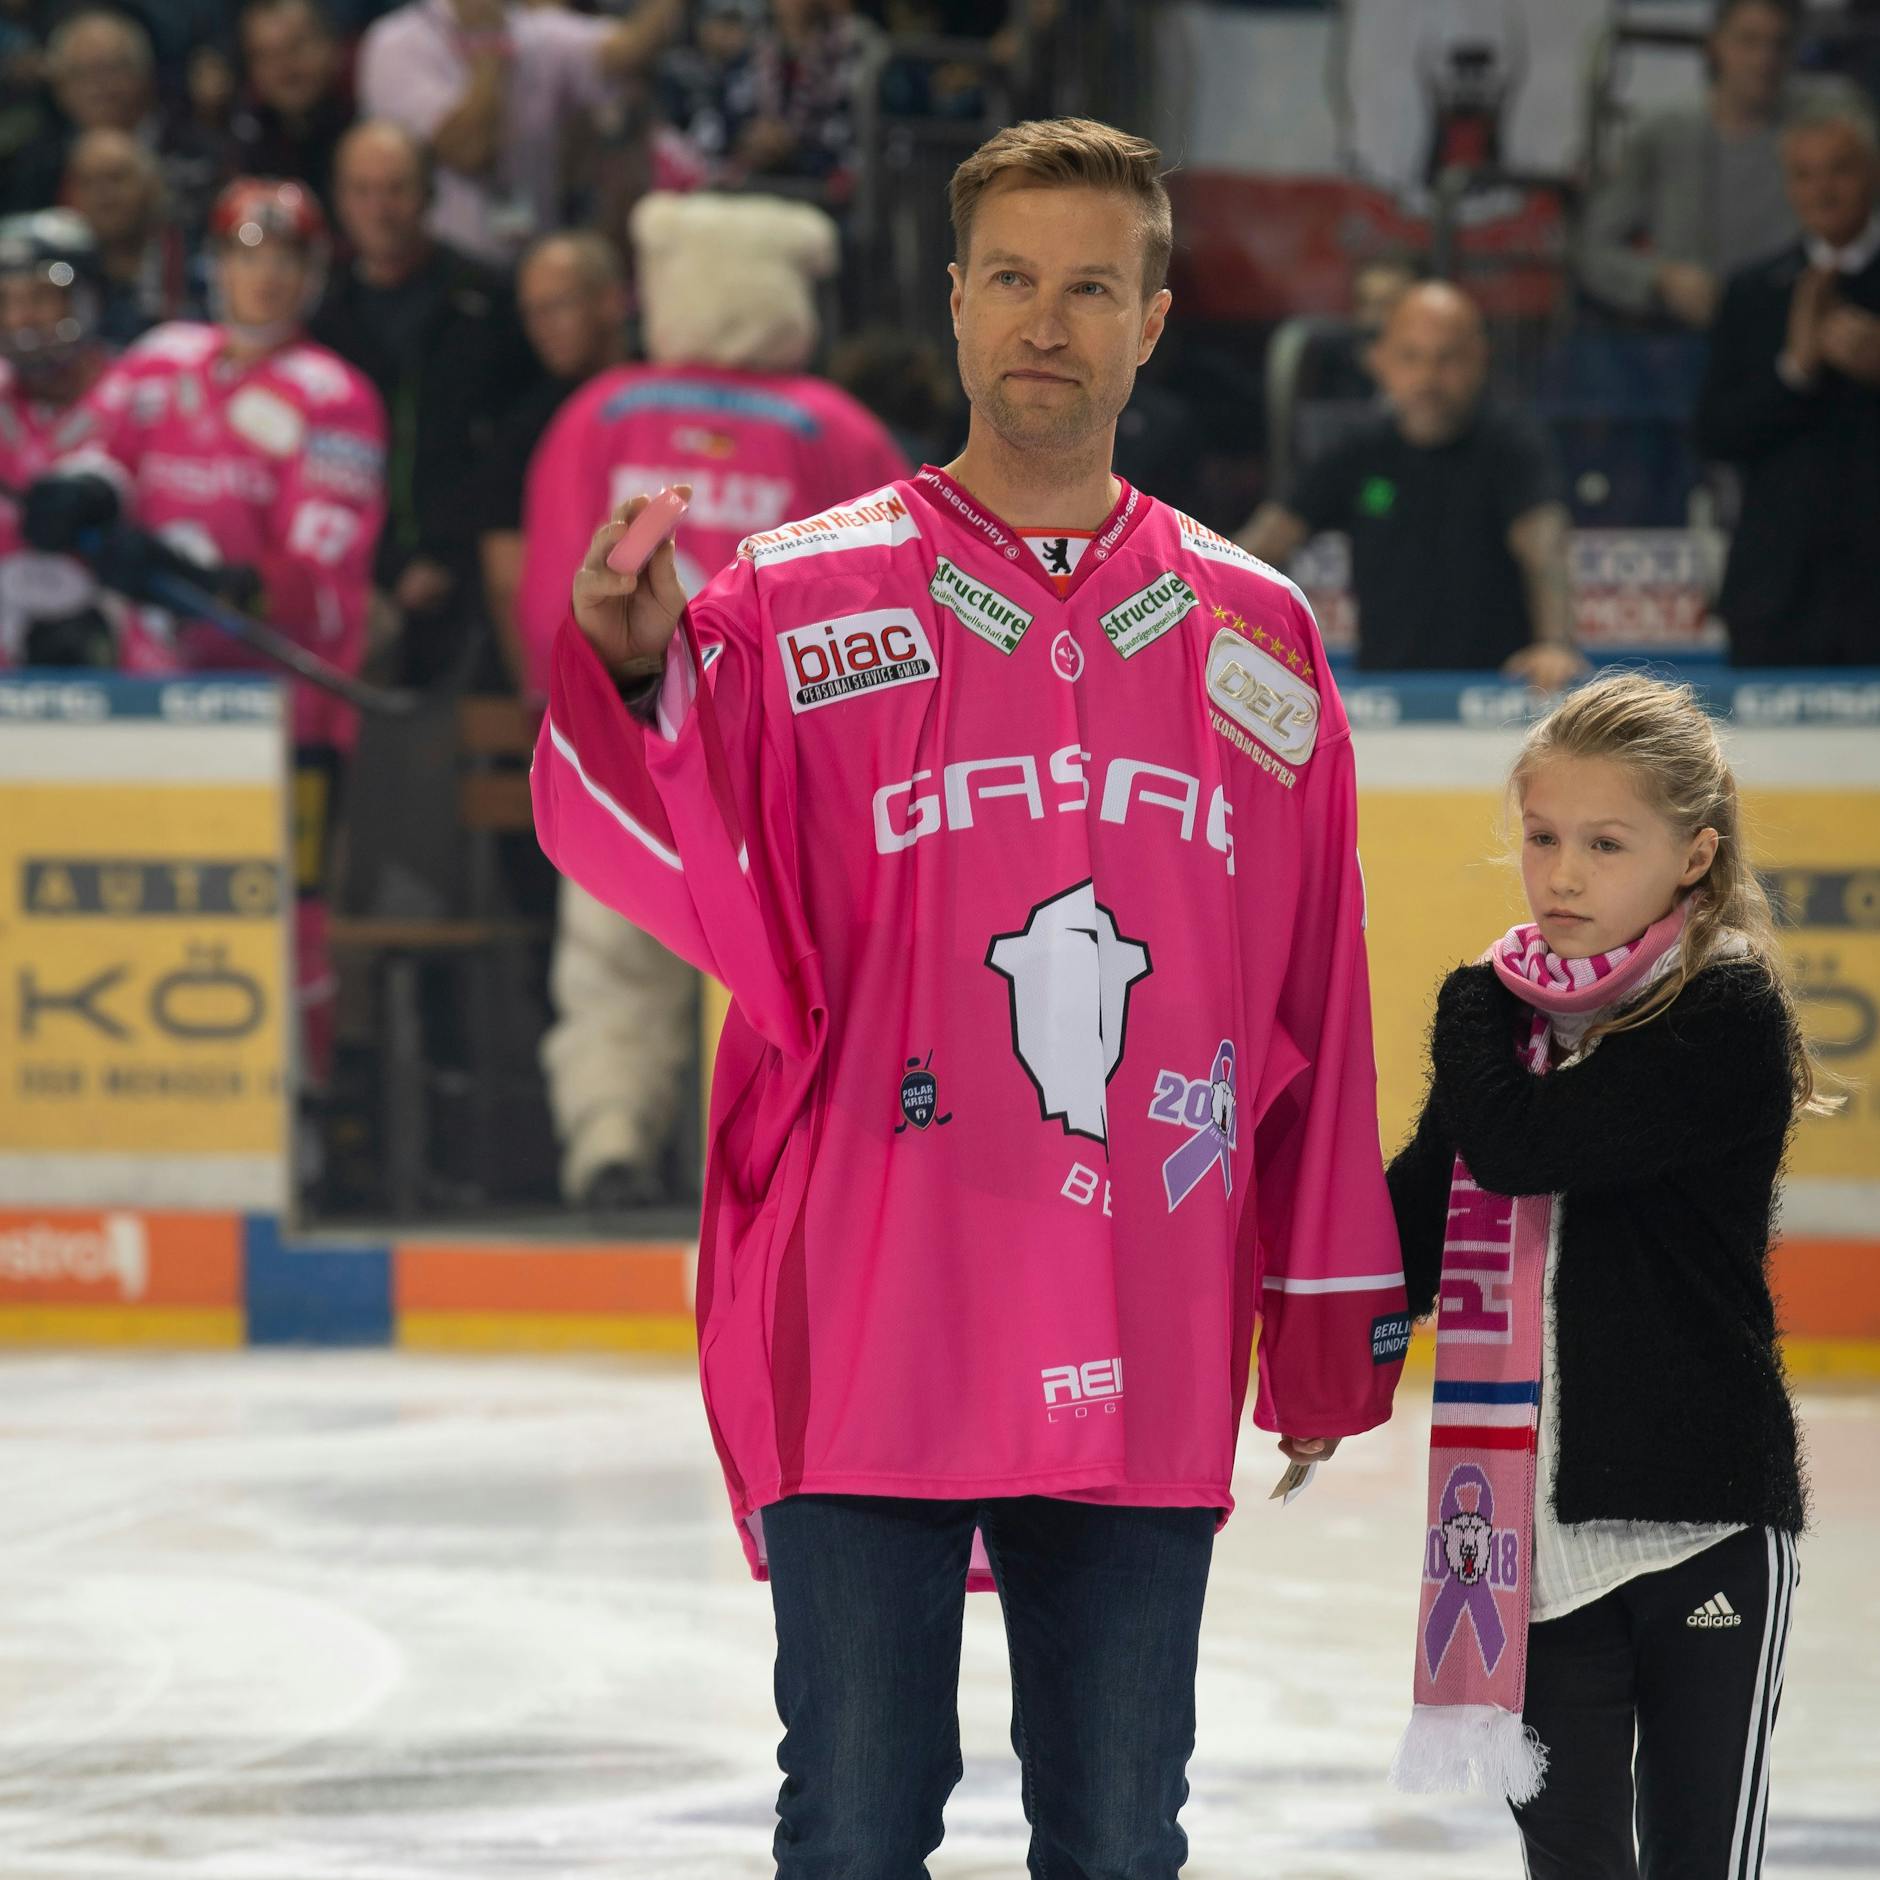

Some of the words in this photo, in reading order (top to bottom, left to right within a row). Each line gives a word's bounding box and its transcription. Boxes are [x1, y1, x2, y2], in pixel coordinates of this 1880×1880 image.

[1105, 578, 1185, 641] structue
[787, 626, 917, 687] biac
[896, 662, 926, 679] GMBH
[33, 862, 279, 914] AUTO
[19, 942, 267, 1041] KÖ
[902, 1084, 933, 1099] POLAR
[904, 1095, 933, 1108] KREIS
[1374, 1320, 1410, 1340] BERLI
[1041, 1357, 1123, 1404] REI
[1686, 1614, 1742, 1628] adidas
